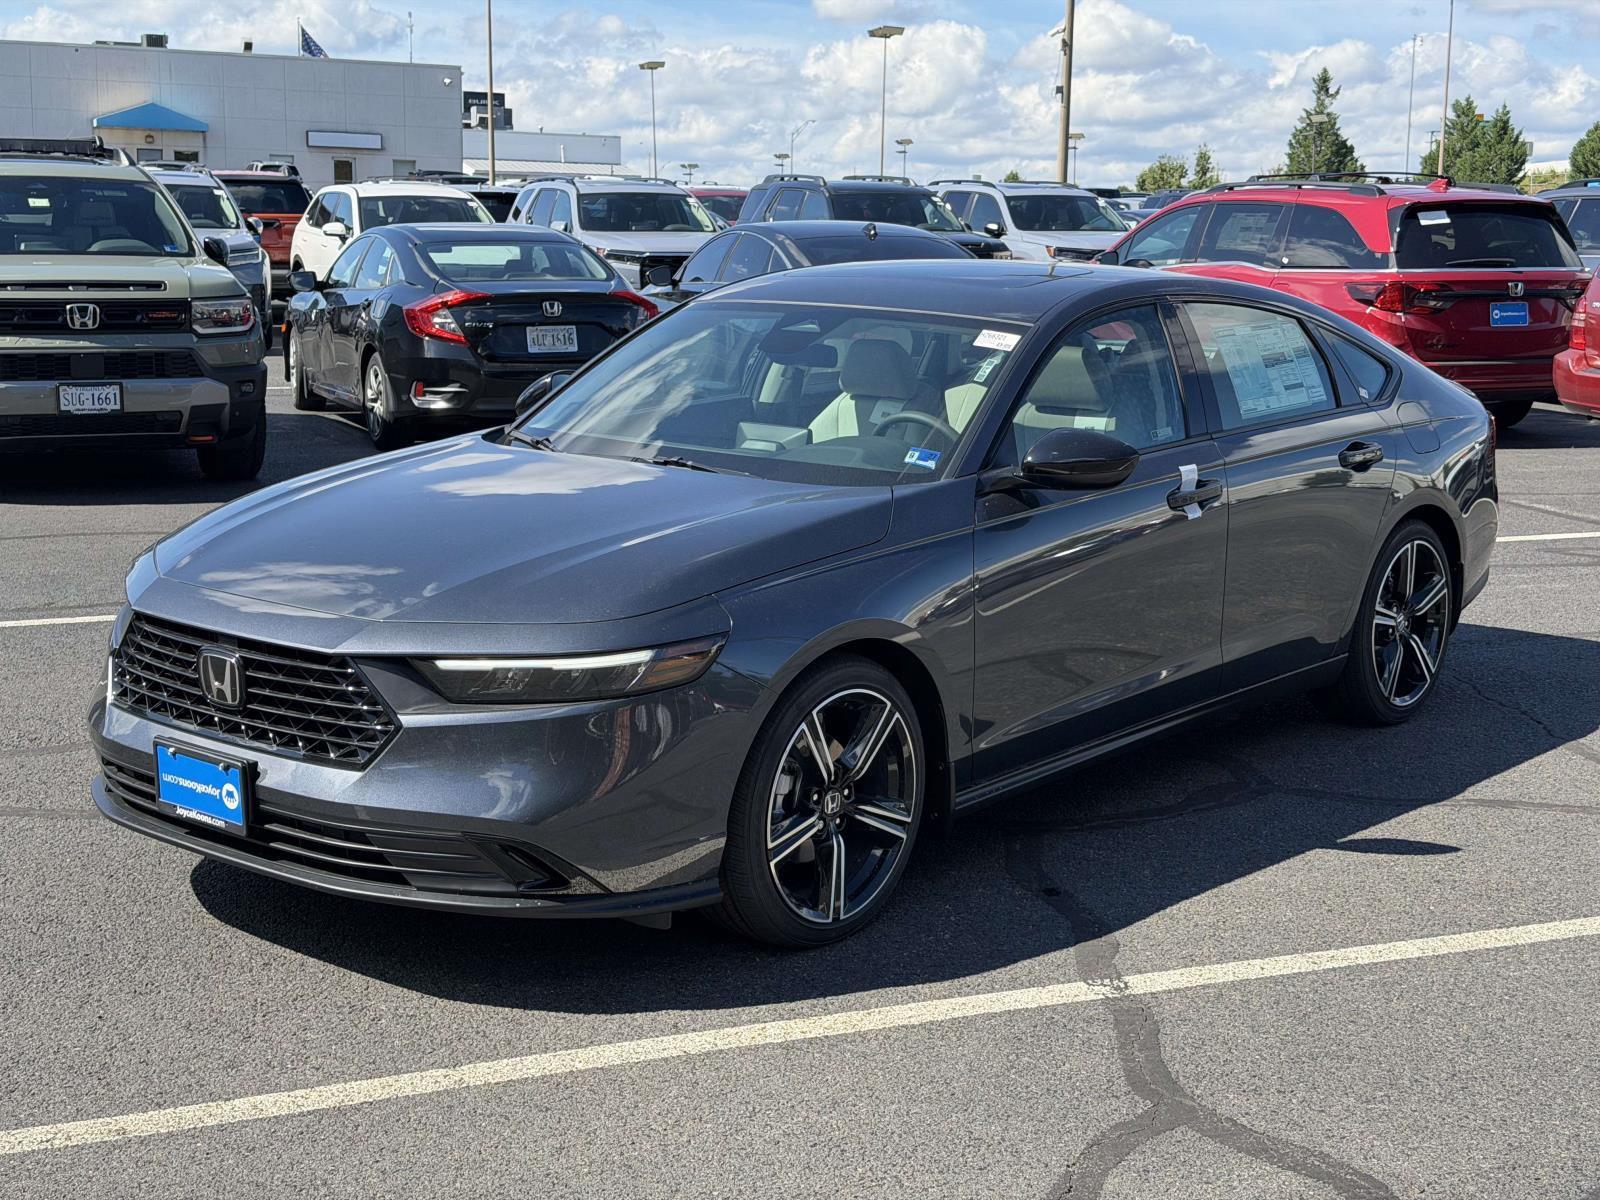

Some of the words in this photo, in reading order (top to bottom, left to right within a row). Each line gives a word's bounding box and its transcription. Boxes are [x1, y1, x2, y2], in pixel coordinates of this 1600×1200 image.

[63, 391, 118, 407] SUG-1661
[162, 772, 221, 799] JoyceKoons.com
[176, 805, 226, 828] JoyceKoons.com
